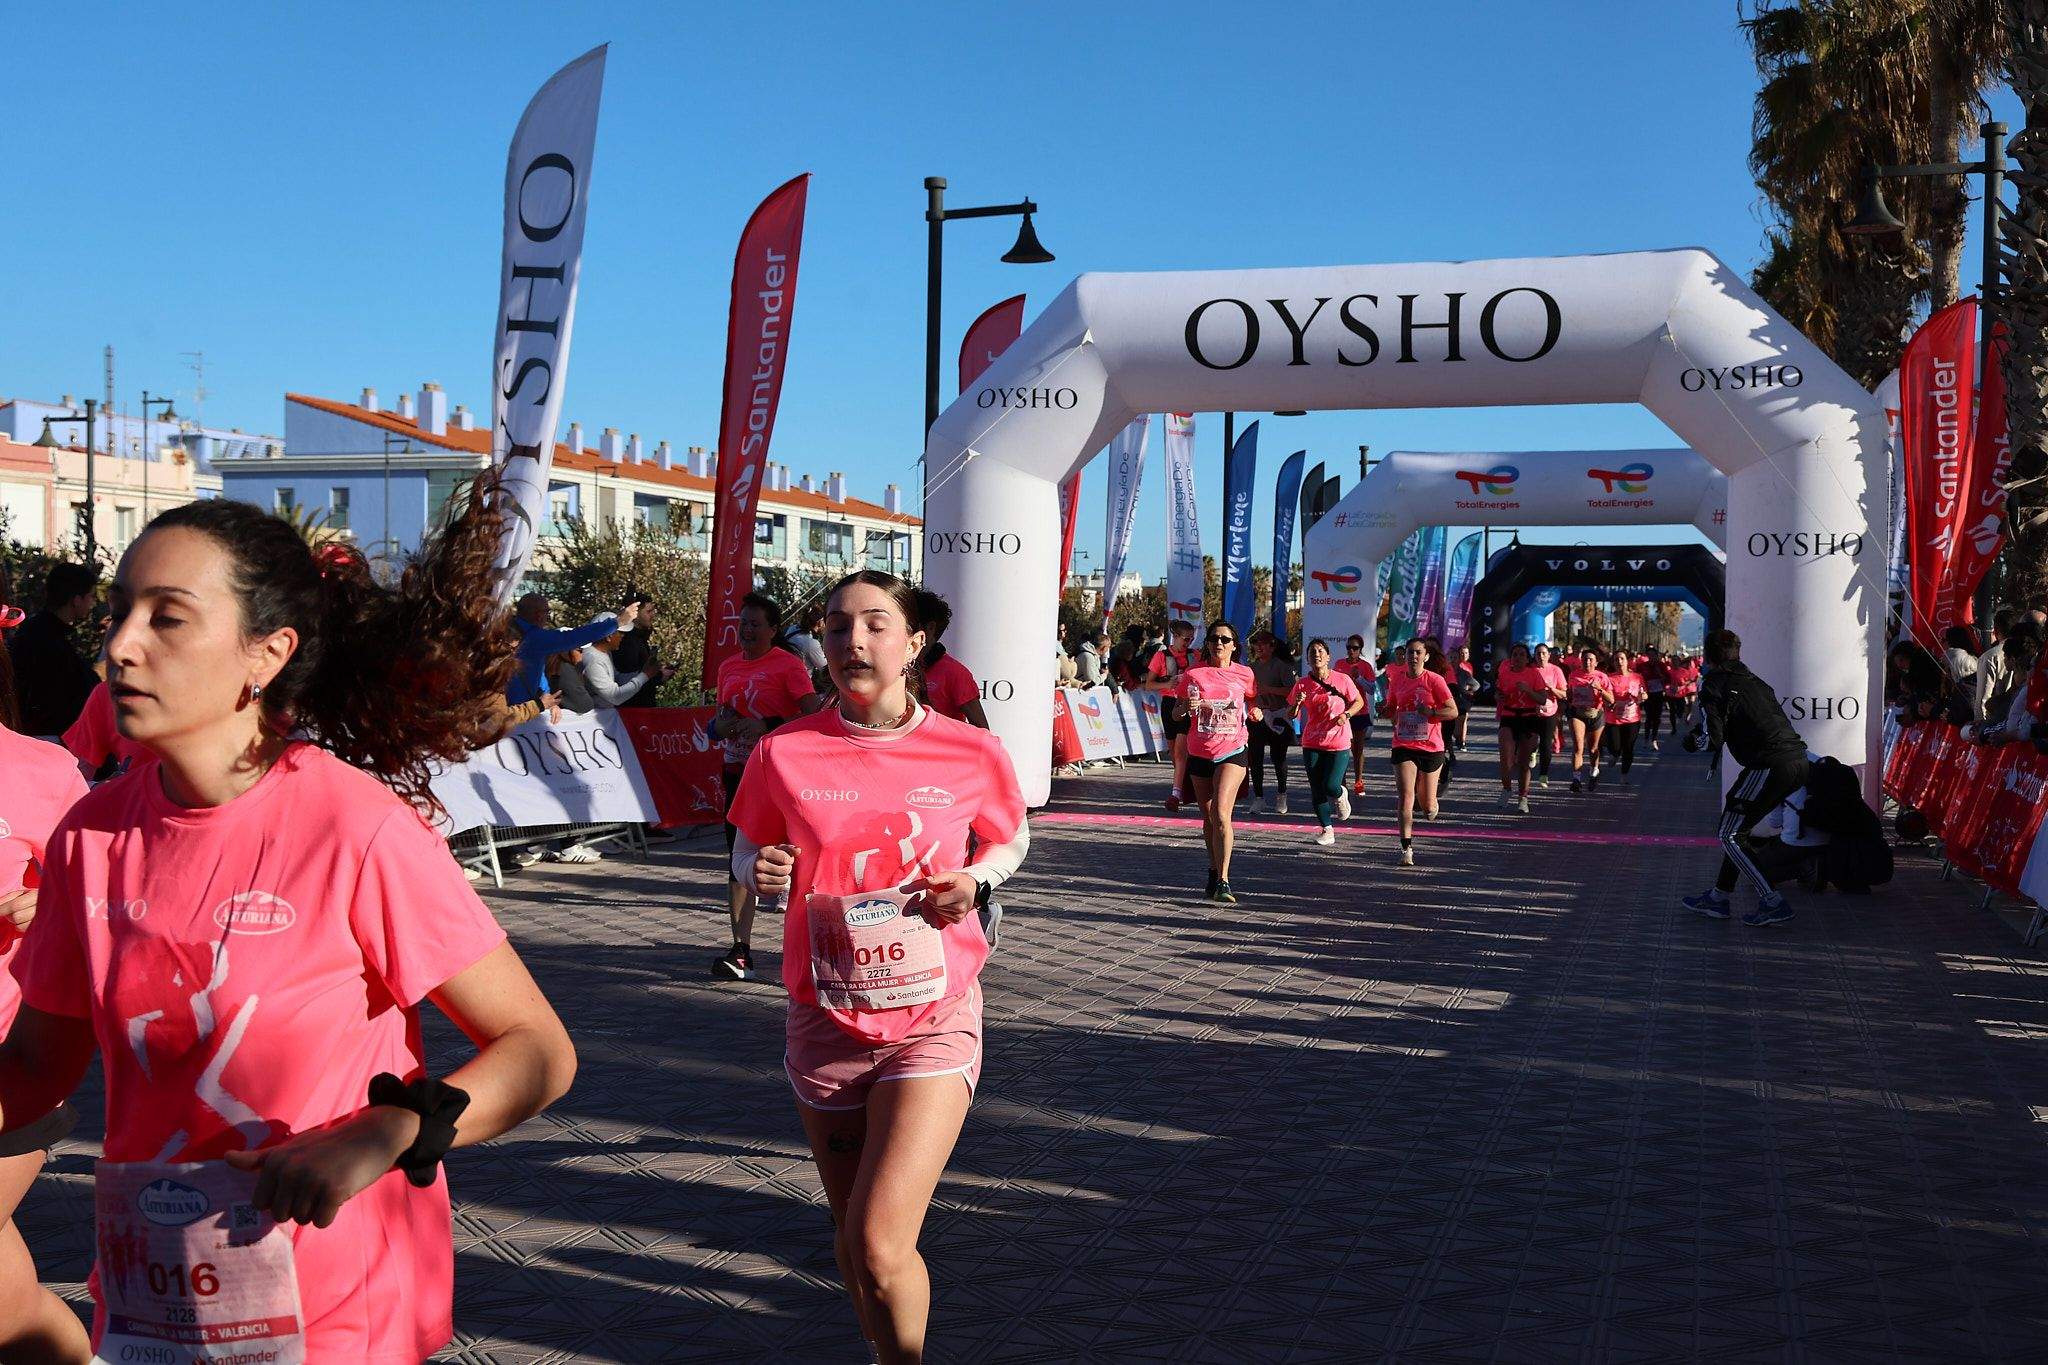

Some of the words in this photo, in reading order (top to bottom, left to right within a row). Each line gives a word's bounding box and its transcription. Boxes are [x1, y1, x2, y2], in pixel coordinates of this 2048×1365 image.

[1184, 286, 1562, 371] OYSHO
[741, 247, 788, 456] Santander
[1679, 365, 1804, 392] OYSHO
[976, 387, 1079, 410] OYSHO
[1928, 357, 1959, 519] Santander
[1455, 501, 1520, 511] TotalEnergies
[1587, 498, 1654, 509] TotalEnergies
[929, 531, 1021, 556] OYSHO
[1226, 491, 1249, 584] Marlene
[1747, 532, 1864, 558] OYSHO
[1545, 559, 1672, 571] VOLVO
[1310, 597, 1362, 607] TotalEnergies
[1483, 605, 1494, 691] VOLVO
[495, 728, 623, 777] OYSHO
[801, 788, 859, 802] OYSHO
[848, 908, 897, 923] ASTURIANA
[854, 941, 906, 967] 016
[866, 968, 892, 979] 2272
[897, 985, 936, 1000] Santander
[149, 1262, 220, 1297] 016
[166, 1307, 197, 1324] 2128
[218, 1323, 271, 1339] VALENCIA
[120, 1344, 176, 1363] OYSHO
